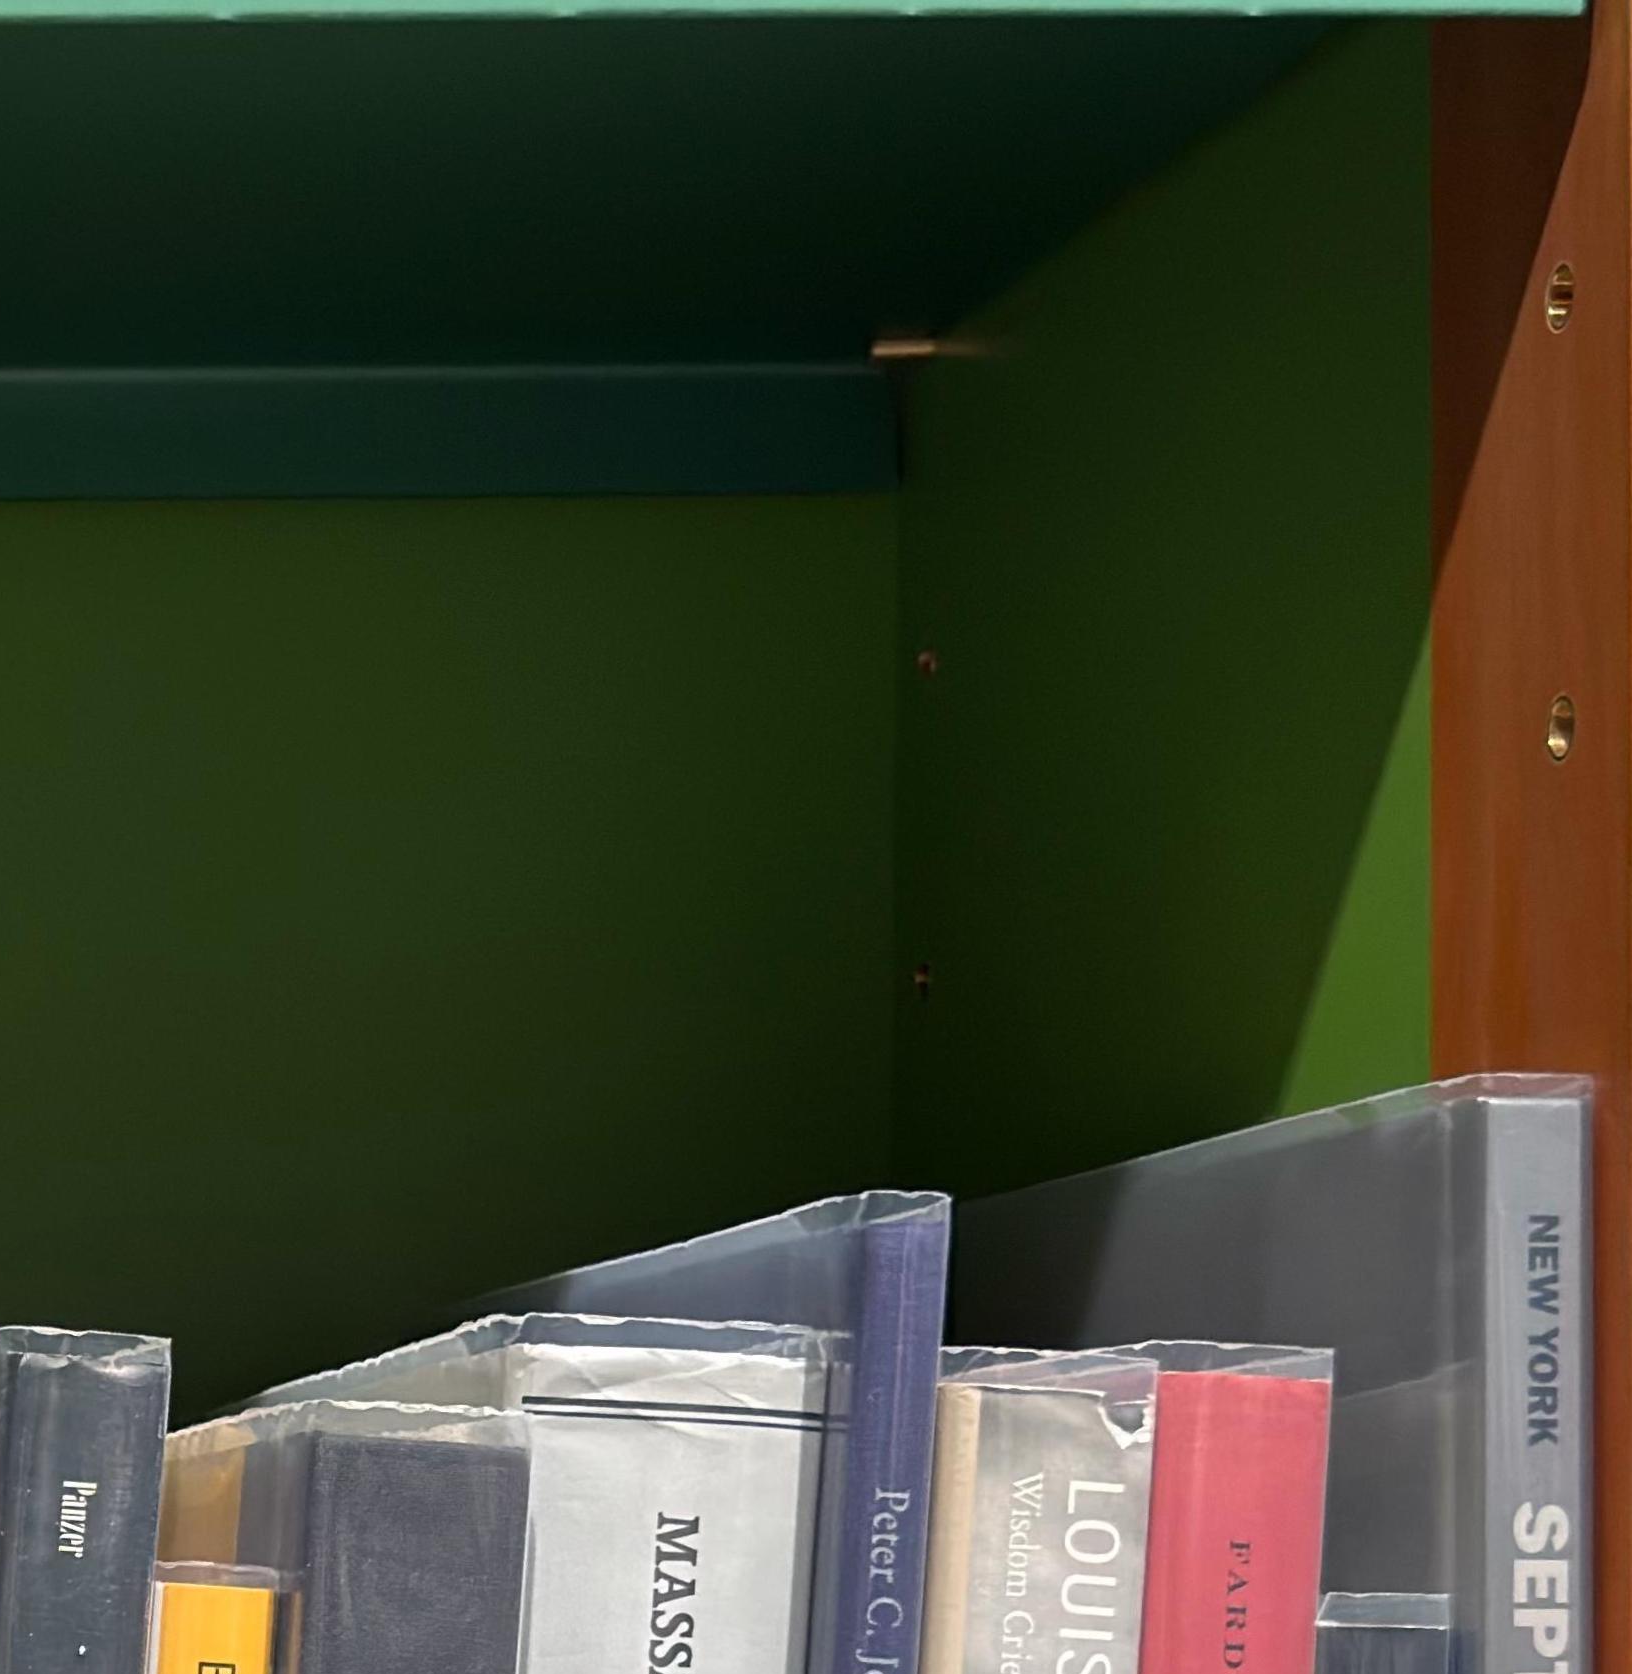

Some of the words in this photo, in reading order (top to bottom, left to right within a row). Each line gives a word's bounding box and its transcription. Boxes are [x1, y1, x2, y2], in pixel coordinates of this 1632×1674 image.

[1529, 1214, 1560, 1315] NEW
[1527, 1326, 1560, 1447] YORK
[58, 1480, 98, 1559] Panzer
[1005, 1471, 1044, 1599] Wisdom
